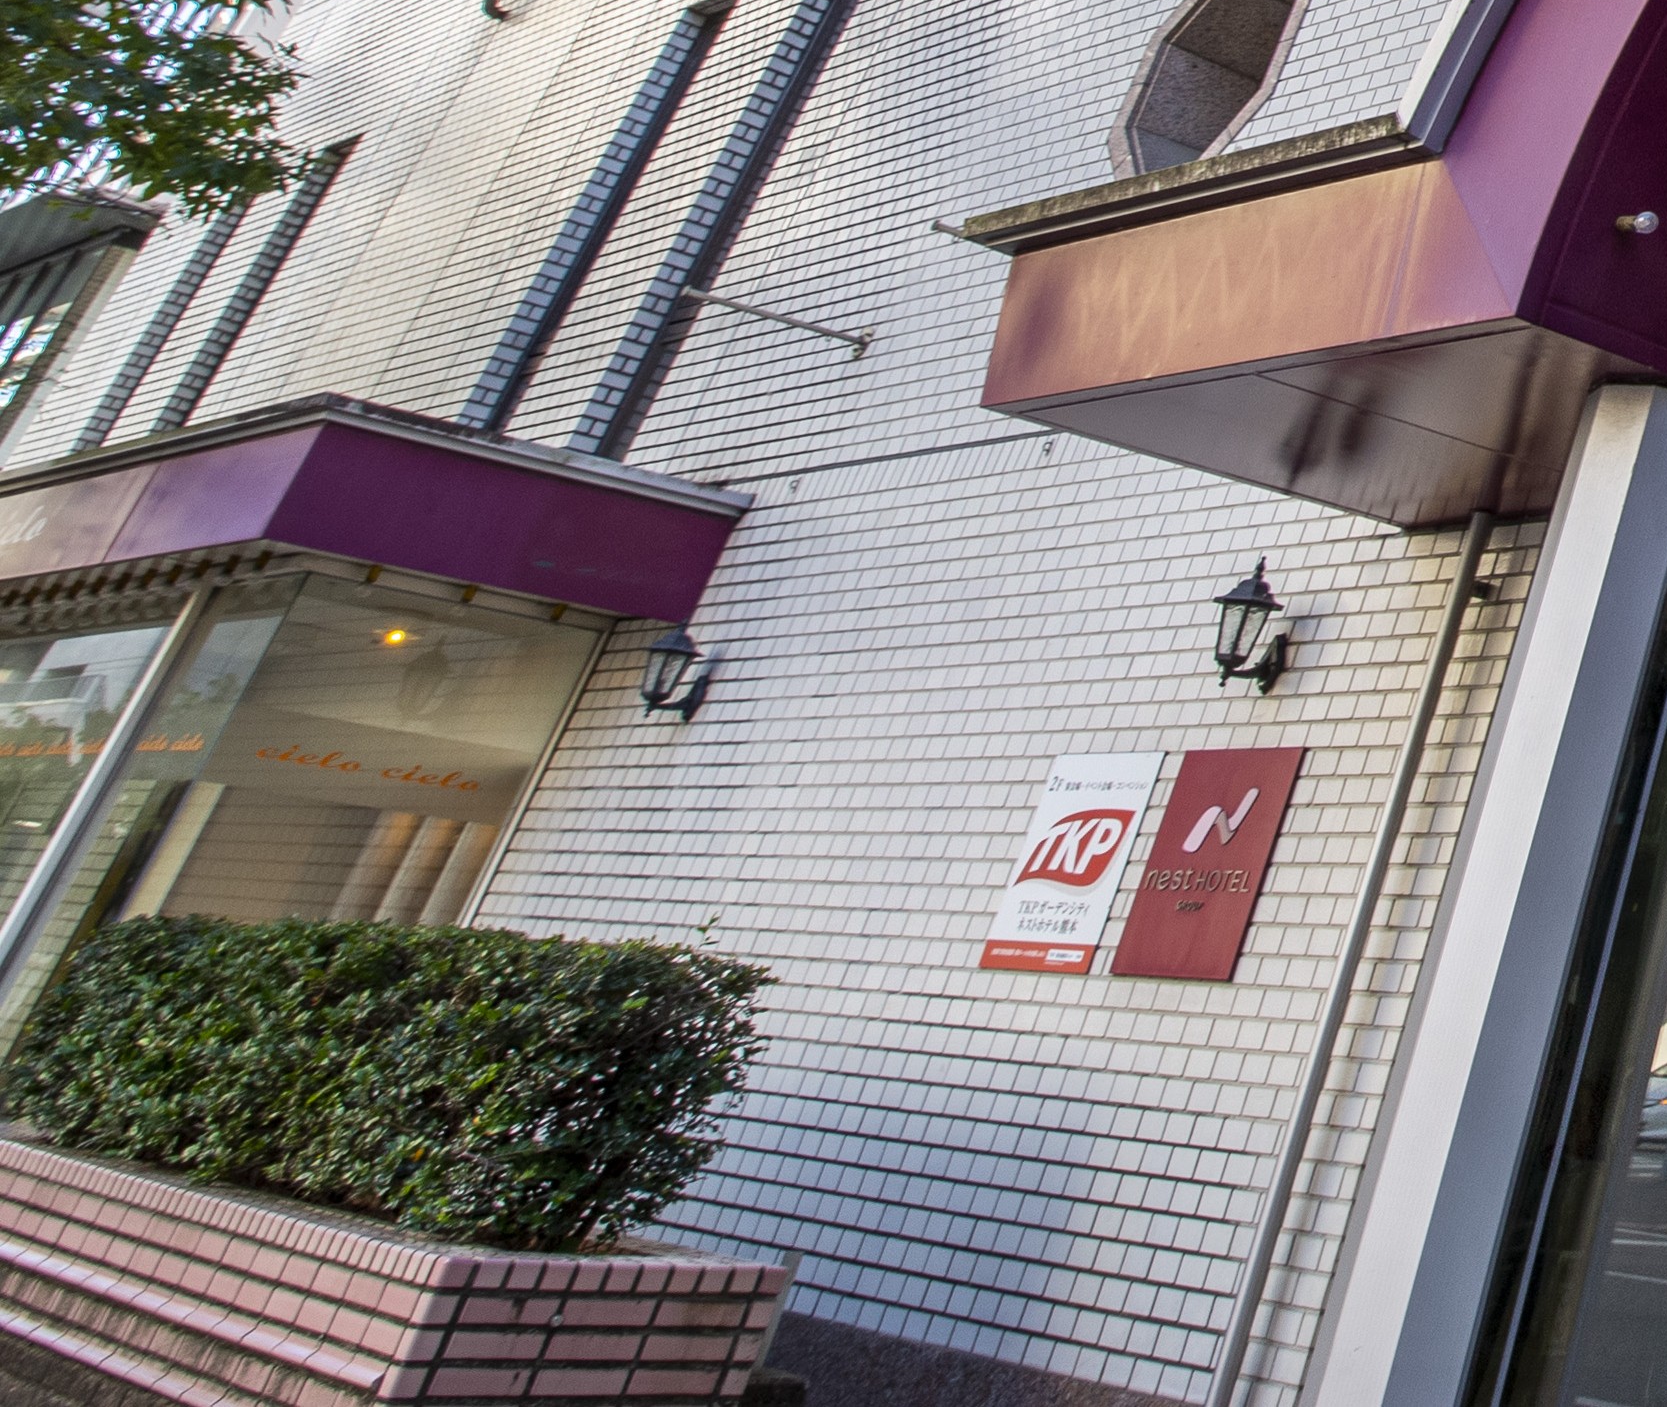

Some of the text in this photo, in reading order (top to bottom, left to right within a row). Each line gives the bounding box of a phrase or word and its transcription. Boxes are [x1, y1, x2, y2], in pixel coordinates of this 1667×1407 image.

[1029, 818, 1124, 874] TKP
[1144, 867, 1250, 892] nest HOTEL
